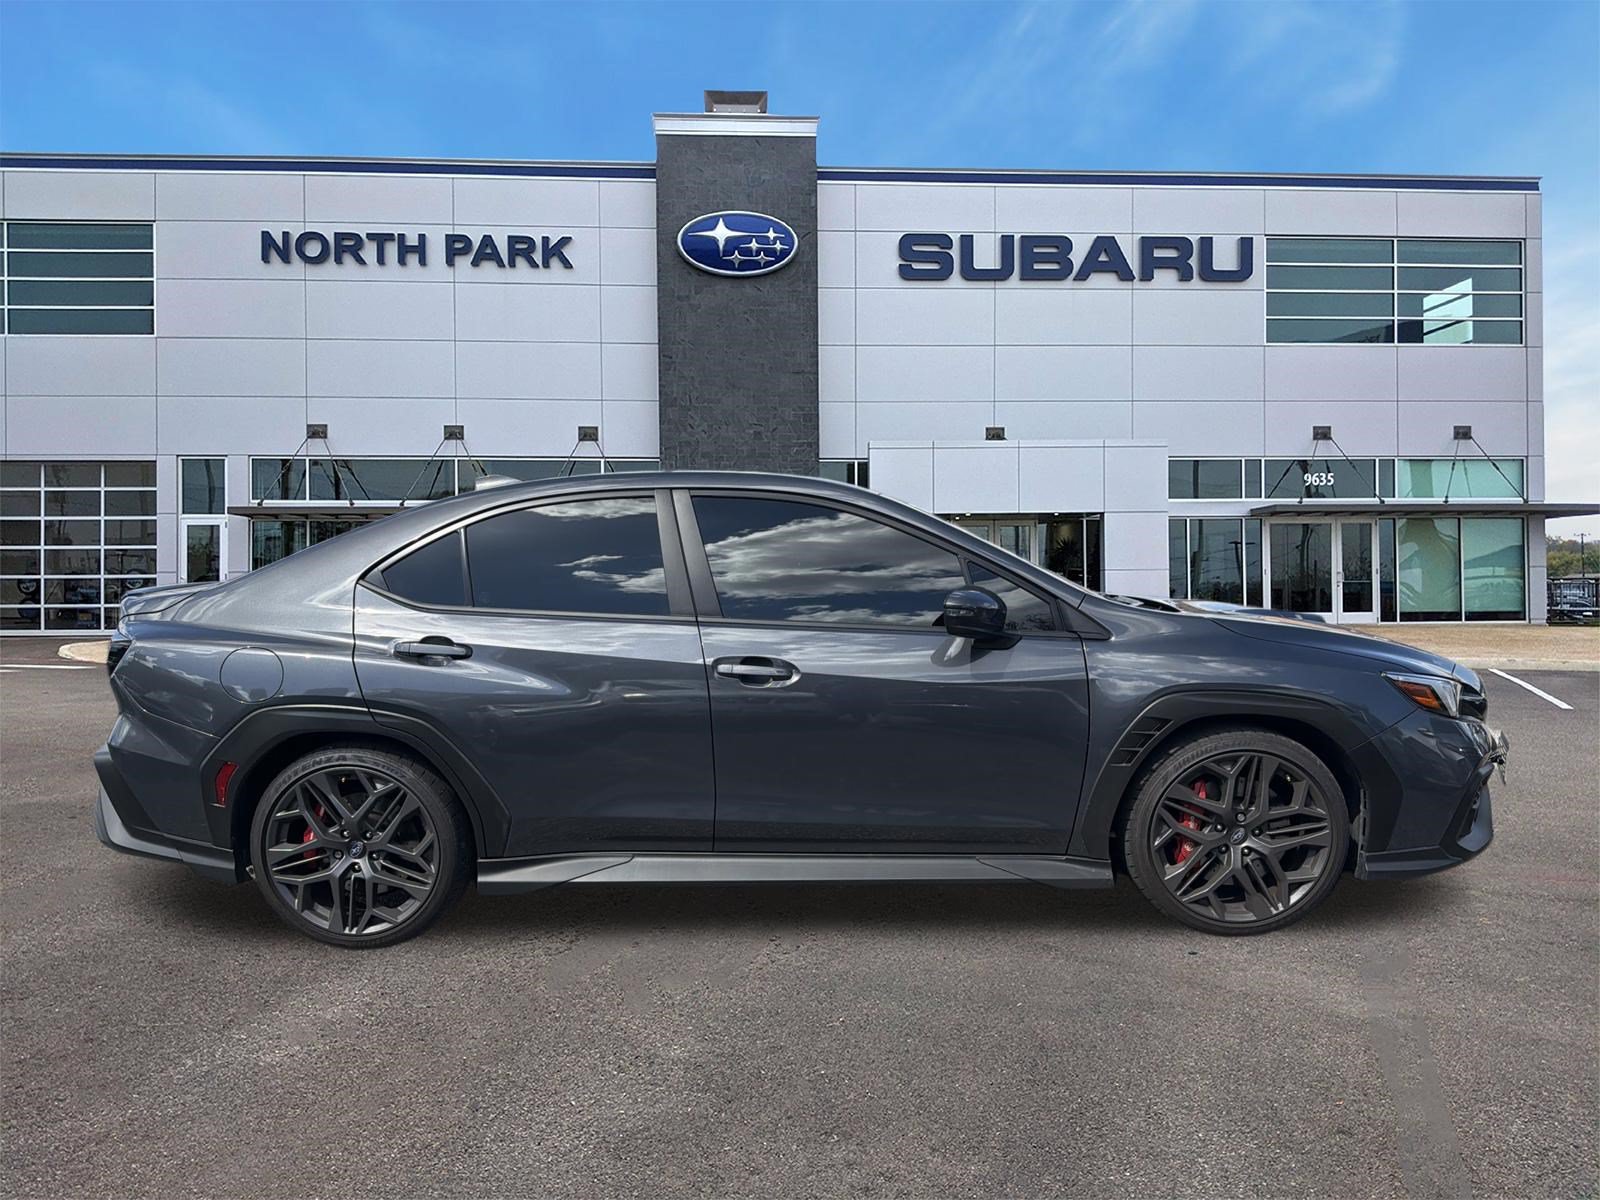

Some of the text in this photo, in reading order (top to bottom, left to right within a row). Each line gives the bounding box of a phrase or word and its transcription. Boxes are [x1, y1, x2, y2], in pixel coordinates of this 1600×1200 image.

[260, 230, 574, 269] NORTH PARK
[898, 233, 1254, 282] SUBARU
[1303, 472, 1335, 486] 9635
